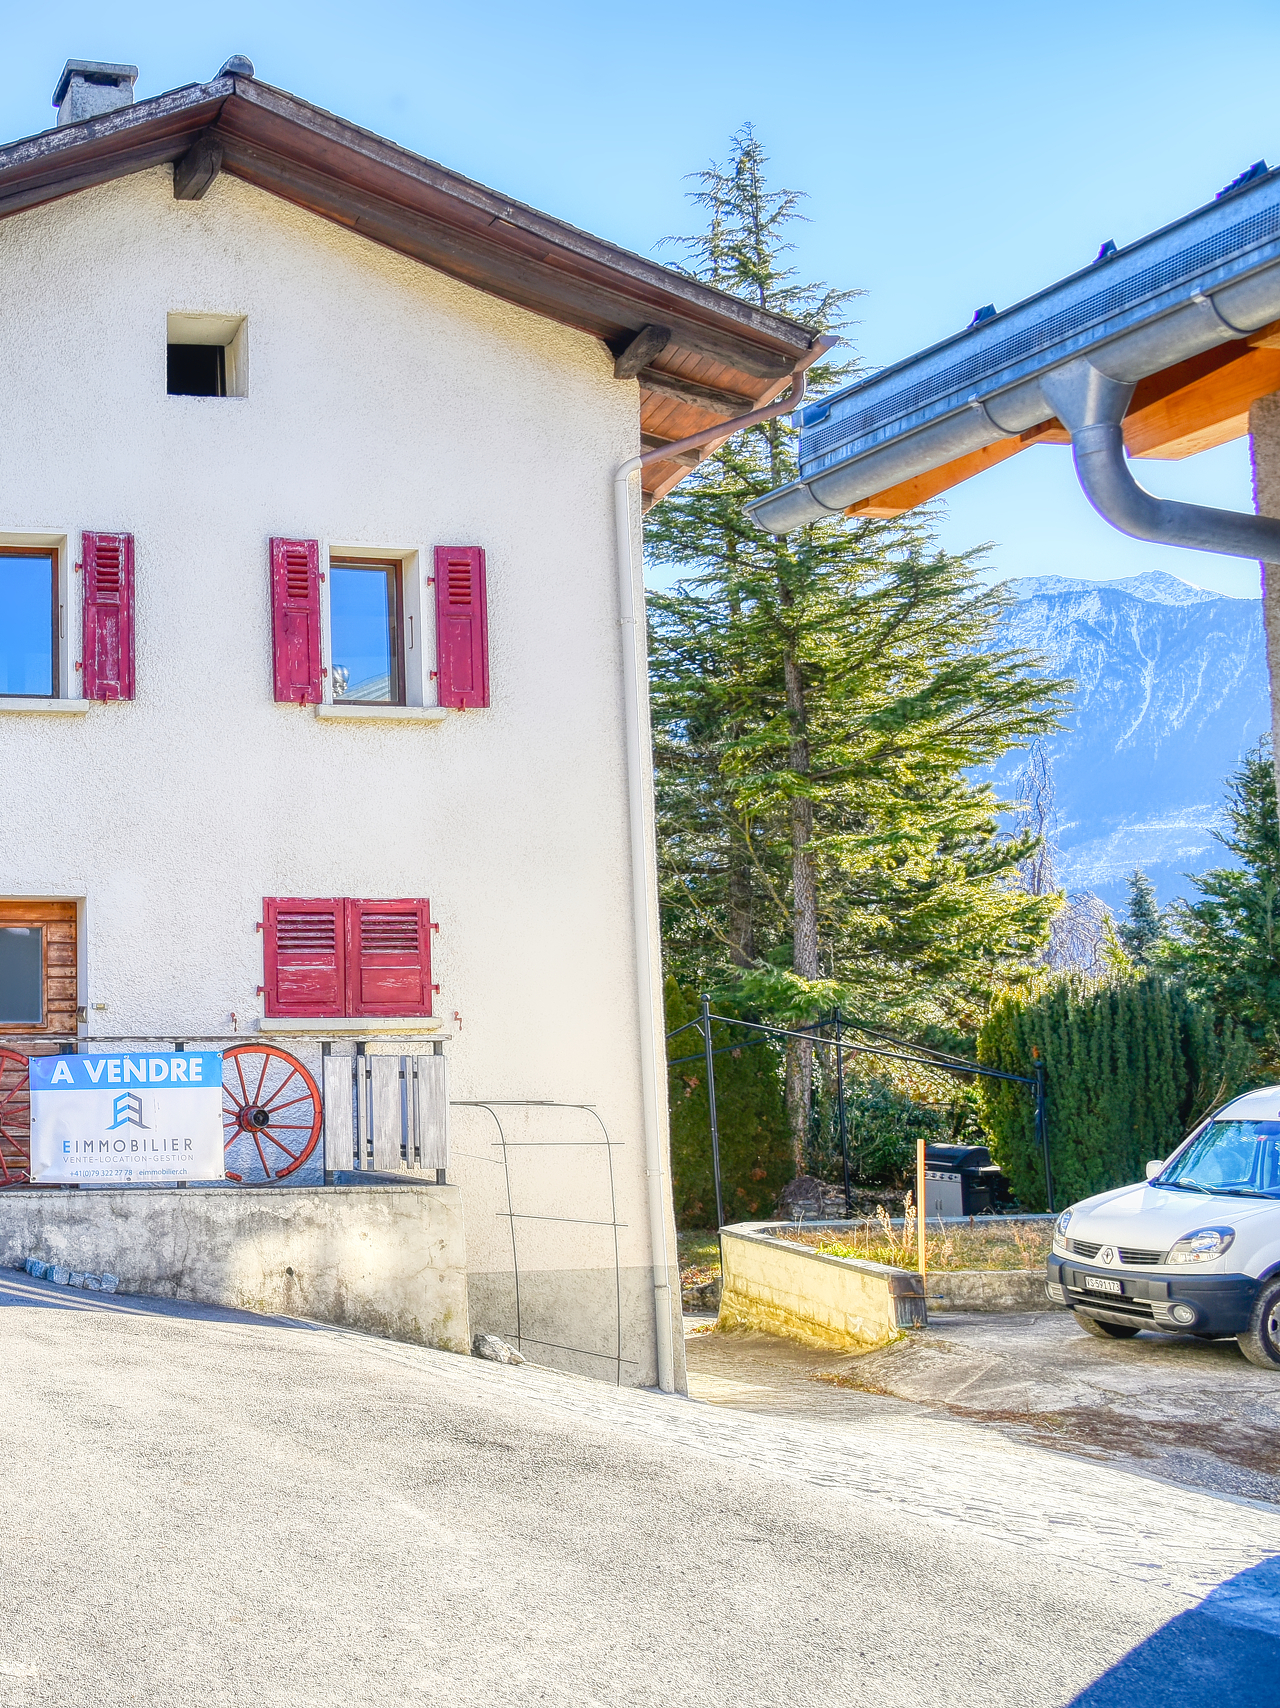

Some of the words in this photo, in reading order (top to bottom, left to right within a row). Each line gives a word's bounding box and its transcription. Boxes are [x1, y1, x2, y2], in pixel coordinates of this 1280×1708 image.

[51, 1060, 74, 1084] A
[82, 1057, 203, 1083] VENDRE
[62, 1138, 193, 1154] EIMMOBILIER
[62, 1154, 194, 1163] VENTE-LOCATION-GESTION
[101, 1169, 113, 1177] 322
[138, 1167, 188, 1176] eimmobilier.ch
